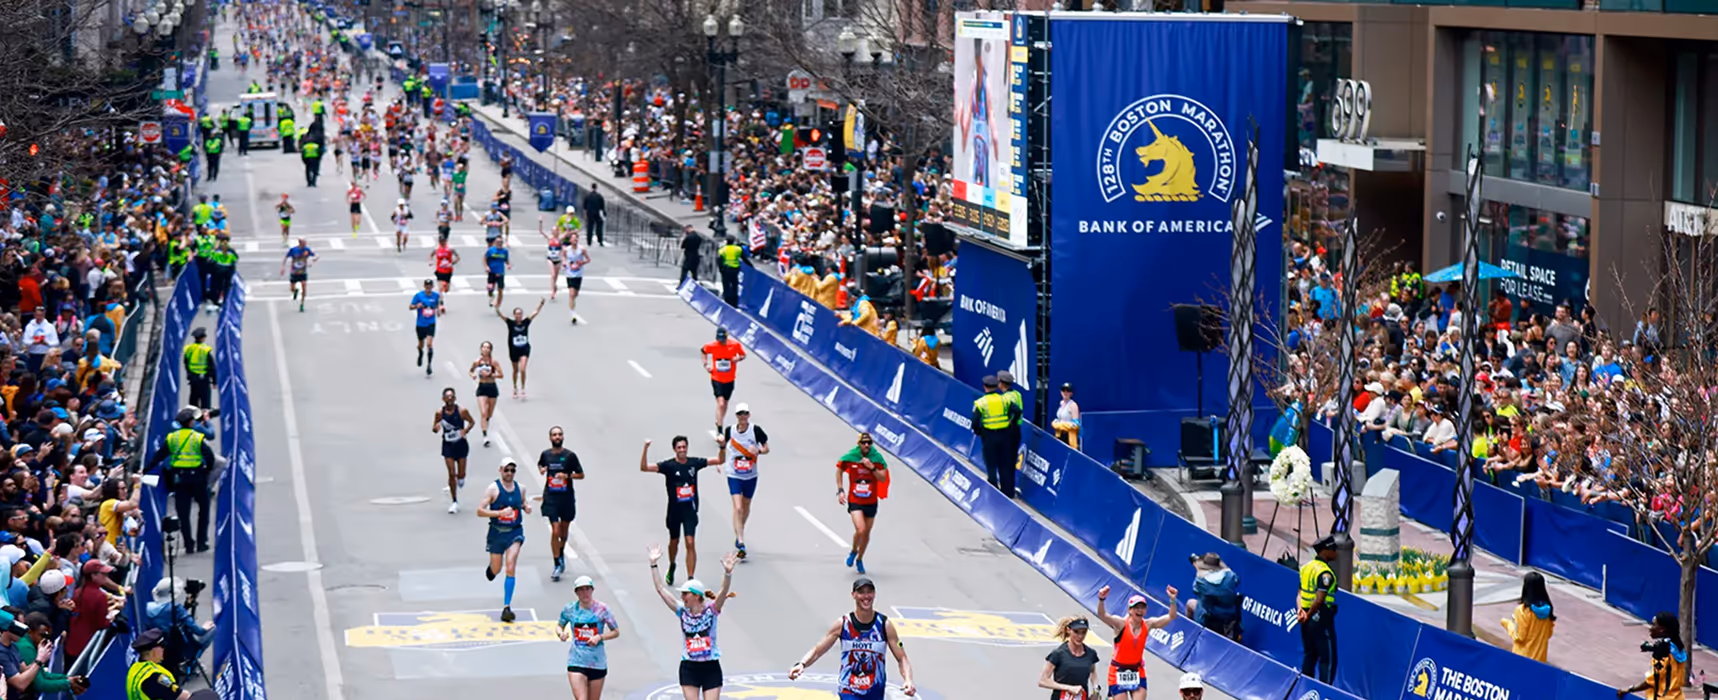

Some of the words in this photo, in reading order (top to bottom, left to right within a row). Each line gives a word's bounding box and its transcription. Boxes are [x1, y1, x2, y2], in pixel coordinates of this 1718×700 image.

[1109, 99, 1171, 144] BOSTON
[1181, 102, 1232, 192] MARATHON
[1102, 148, 1118, 194] 128TH
[1079, 220, 1127, 233] BANK
[1132, 220, 1155, 233] OF
[1158, 220, 1233, 233] AMERICA
[1501, 277, 1516, 295] FOR
[1517, 282, 1543, 303] LEASE
[1530, 266, 1556, 286] SPACE
[1242, 596, 1253, 612] OF
[1253, 602, 1283, 627] AMERICA
[1441, 666, 1465, 690] THE
[1462, 675, 1510, 700] BOSTON
